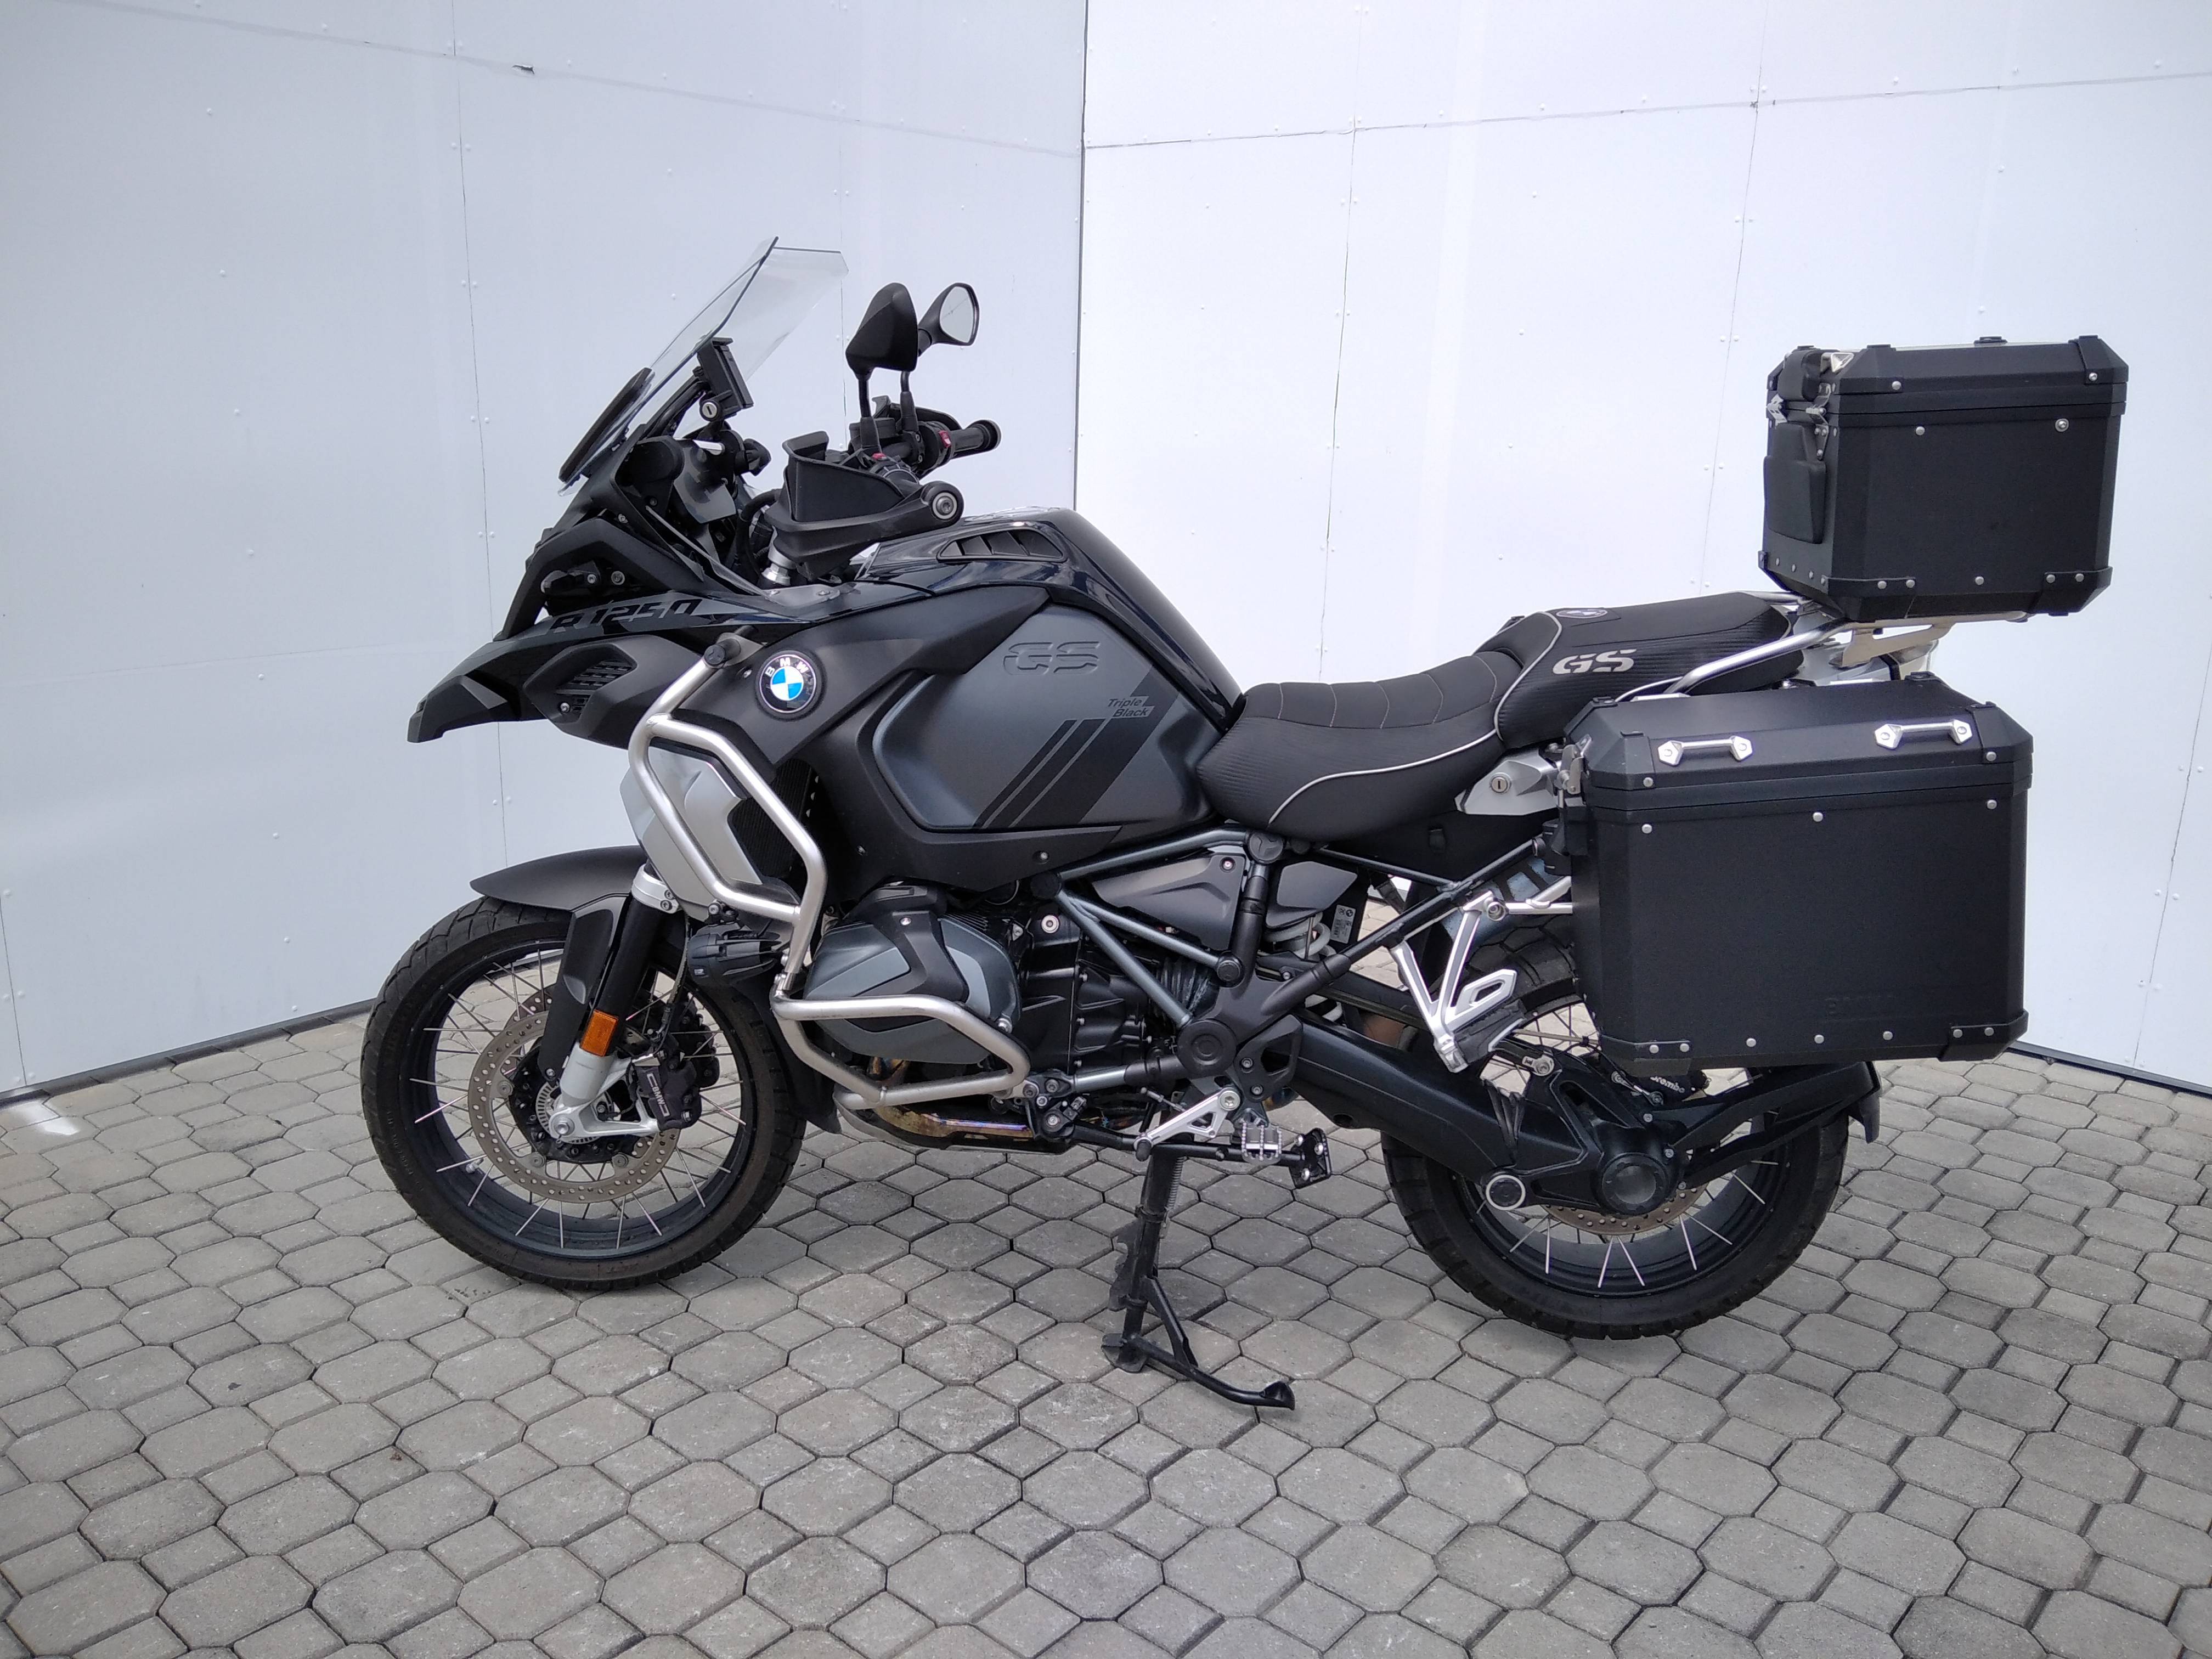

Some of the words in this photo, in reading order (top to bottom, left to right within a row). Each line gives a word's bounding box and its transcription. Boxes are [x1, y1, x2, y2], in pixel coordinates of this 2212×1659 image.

[765, 657, 809, 677] BMW
[1003, 641, 1100, 675] GS
[1553, 648, 1637, 674] GS
[1107, 697, 1143, 708] Triple
[1113, 707, 1149, 718] Black
[652, 1086, 665, 1104] BMW
